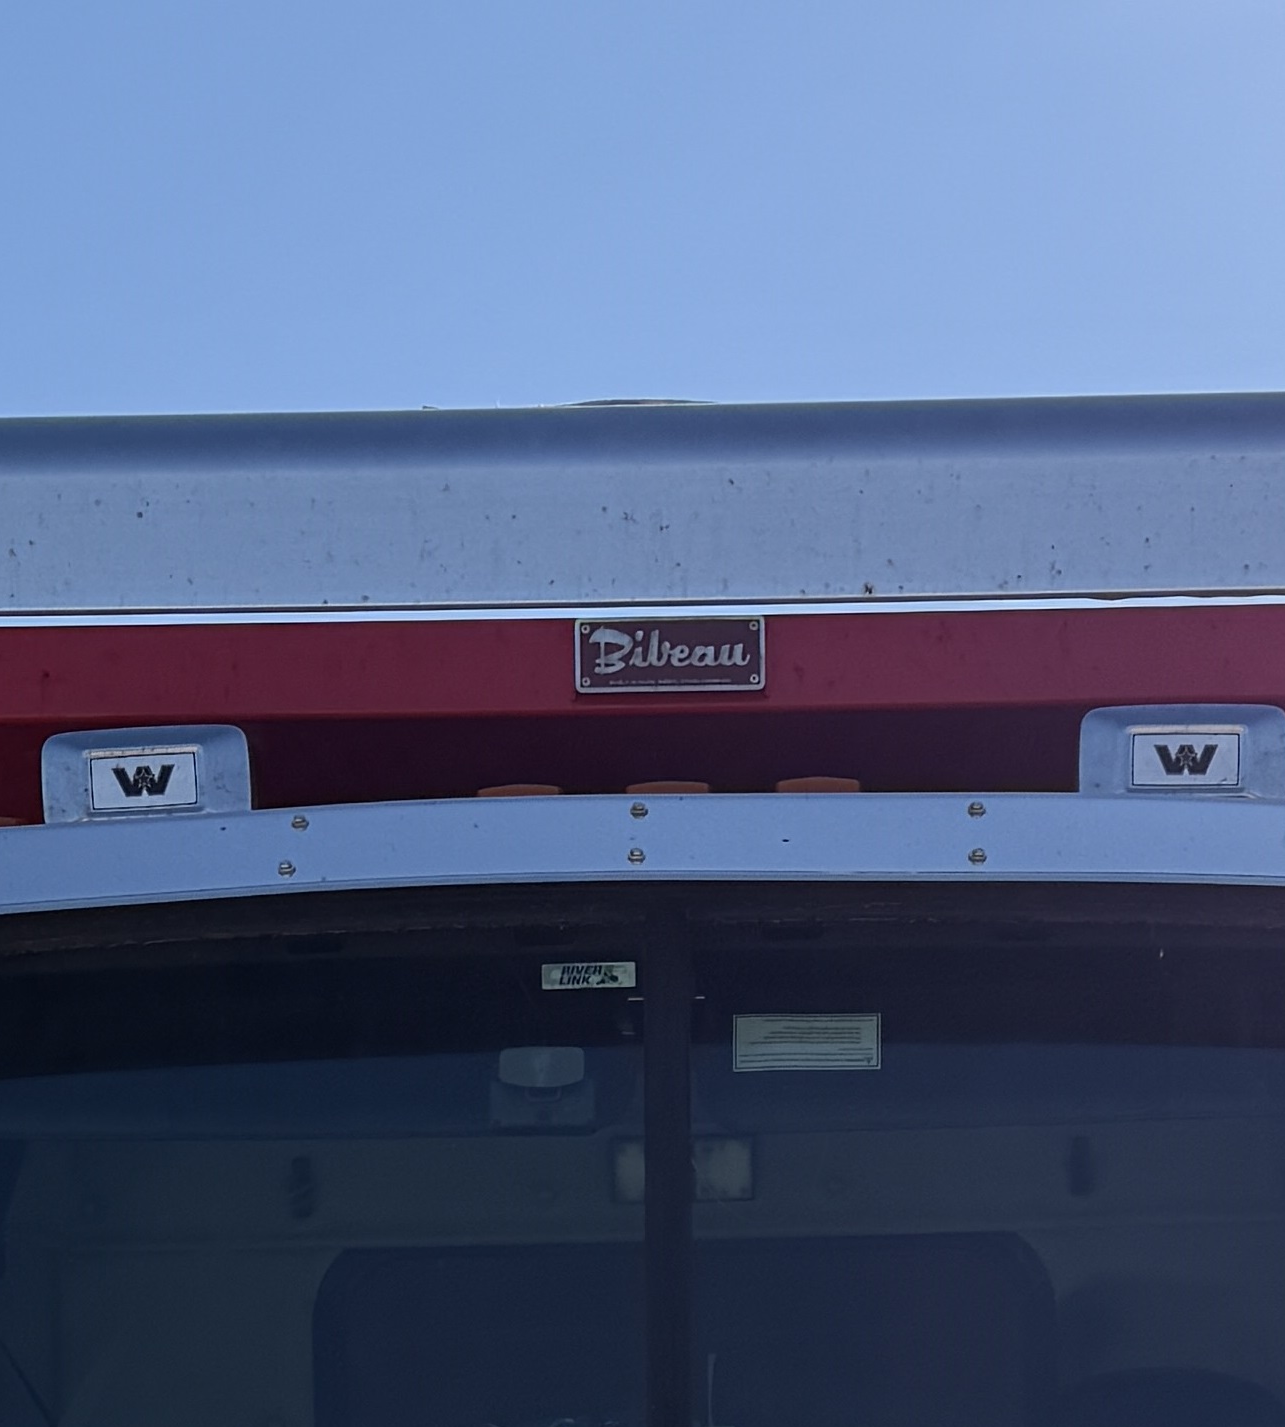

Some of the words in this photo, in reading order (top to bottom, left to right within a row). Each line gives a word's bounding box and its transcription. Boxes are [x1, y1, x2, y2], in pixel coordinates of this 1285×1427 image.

[588, 626, 750, 675] Bibeau
[1153, 744, 1218, 776] W
[111, 764, 175, 797] W
[559, 975, 591, 986] LINK
[561, 965, 603, 976] RIVER
